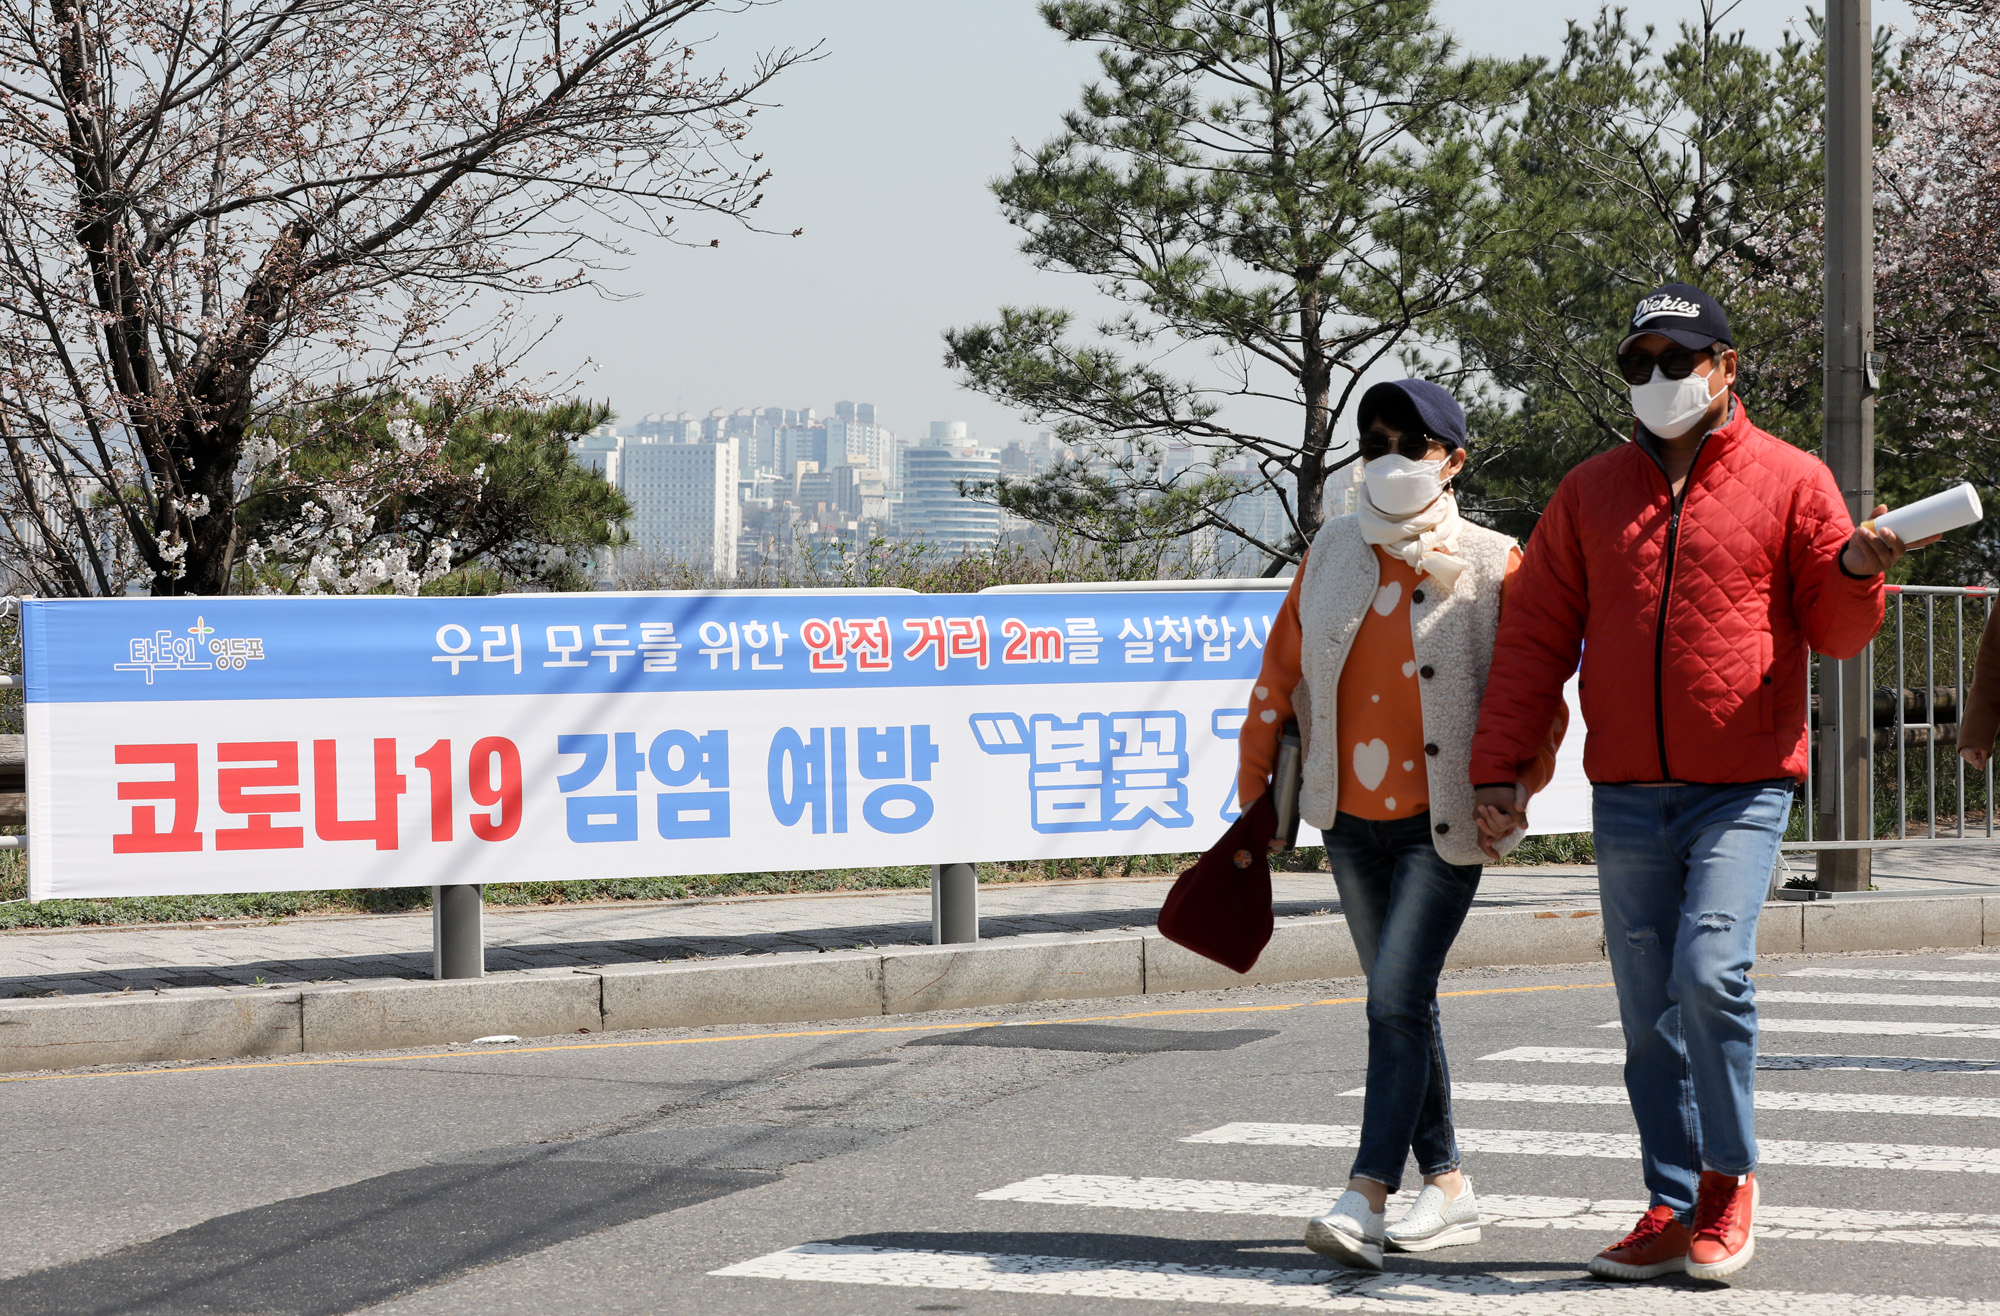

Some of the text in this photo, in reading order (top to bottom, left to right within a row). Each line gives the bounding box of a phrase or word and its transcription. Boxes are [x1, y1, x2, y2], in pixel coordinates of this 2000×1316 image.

[1632, 295, 1701, 323] Dickies
[208, 638, 265, 671] 영등포
[432, 623, 523, 675] 우리
[543, 621, 683, 673] 모두를
[697, 619, 790, 672] 위한
[801, 617, 893, 674] 안전
[902, 614, 991, 671] 거리
[1001, 617, 1104, 666] 2m를
[112, 735, 524, 854] 코로나19
[557, 729, 731, 844] 감염
[768, 724, 940, 835] 예방
